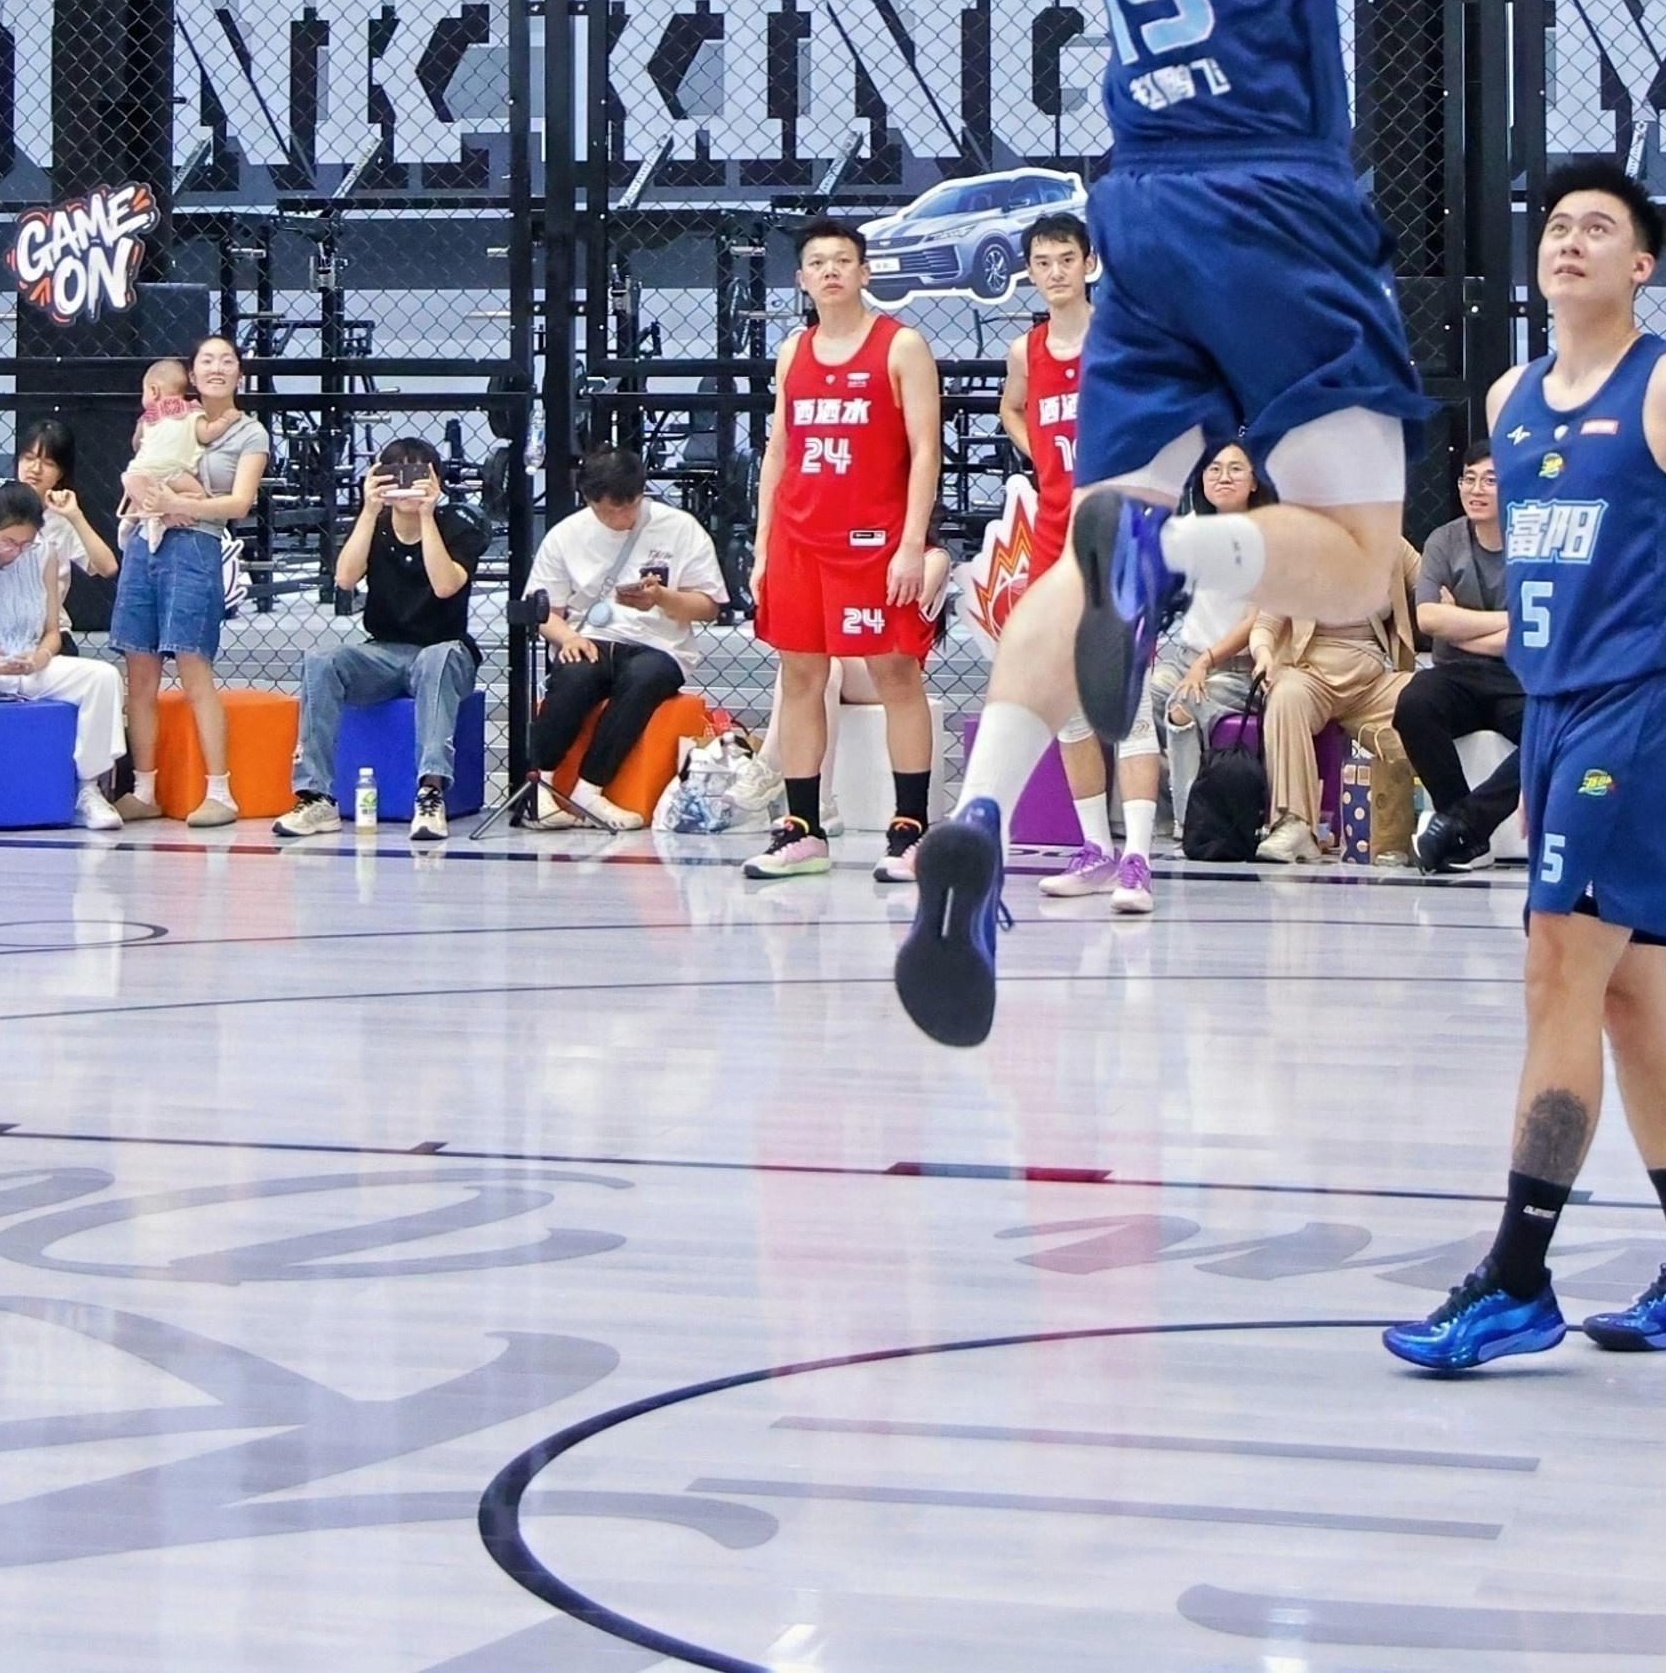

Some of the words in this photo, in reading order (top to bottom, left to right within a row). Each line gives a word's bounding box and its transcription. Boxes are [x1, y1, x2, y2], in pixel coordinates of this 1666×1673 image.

[17, 186, 151, 282] GAME
[53, 238, 134, 317] ON
[801, 437, 852, 475] 24
[1505, 499, 1609, 564] 富阳
[842, 607, 886, 635] 24
[1520, 580, 1553, 649] 5
[1540, 834, 1565, 884] 5
